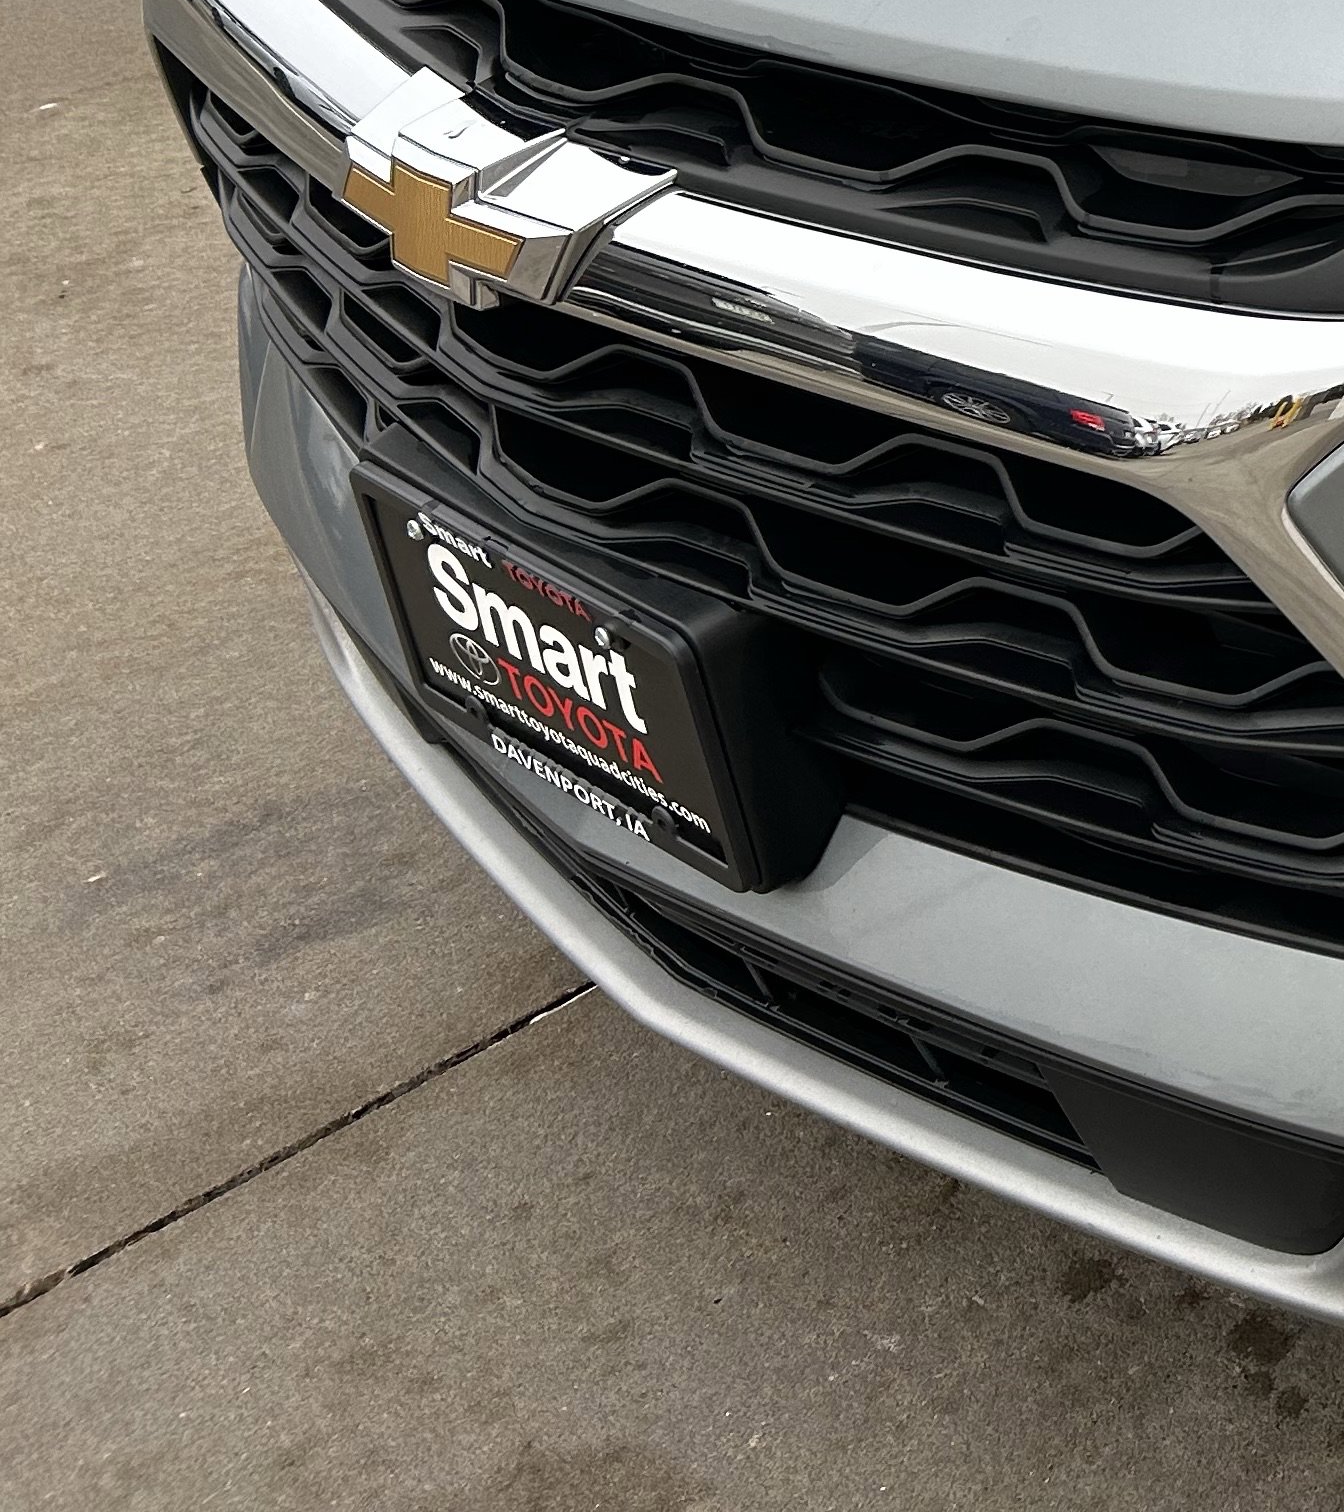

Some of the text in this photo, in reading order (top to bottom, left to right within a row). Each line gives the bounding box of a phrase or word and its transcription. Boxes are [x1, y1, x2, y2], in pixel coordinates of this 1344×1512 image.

[417, 512, 593, 622] Smart TOYOTA
[427, 543, 648, 734] Smart
[430, 657, 712, 835] www.smarttoyotaquadcities.com
[496, 658, 664, 784] TOYOTA
[490, 733, 651, 842] DAVENPORT, IA
